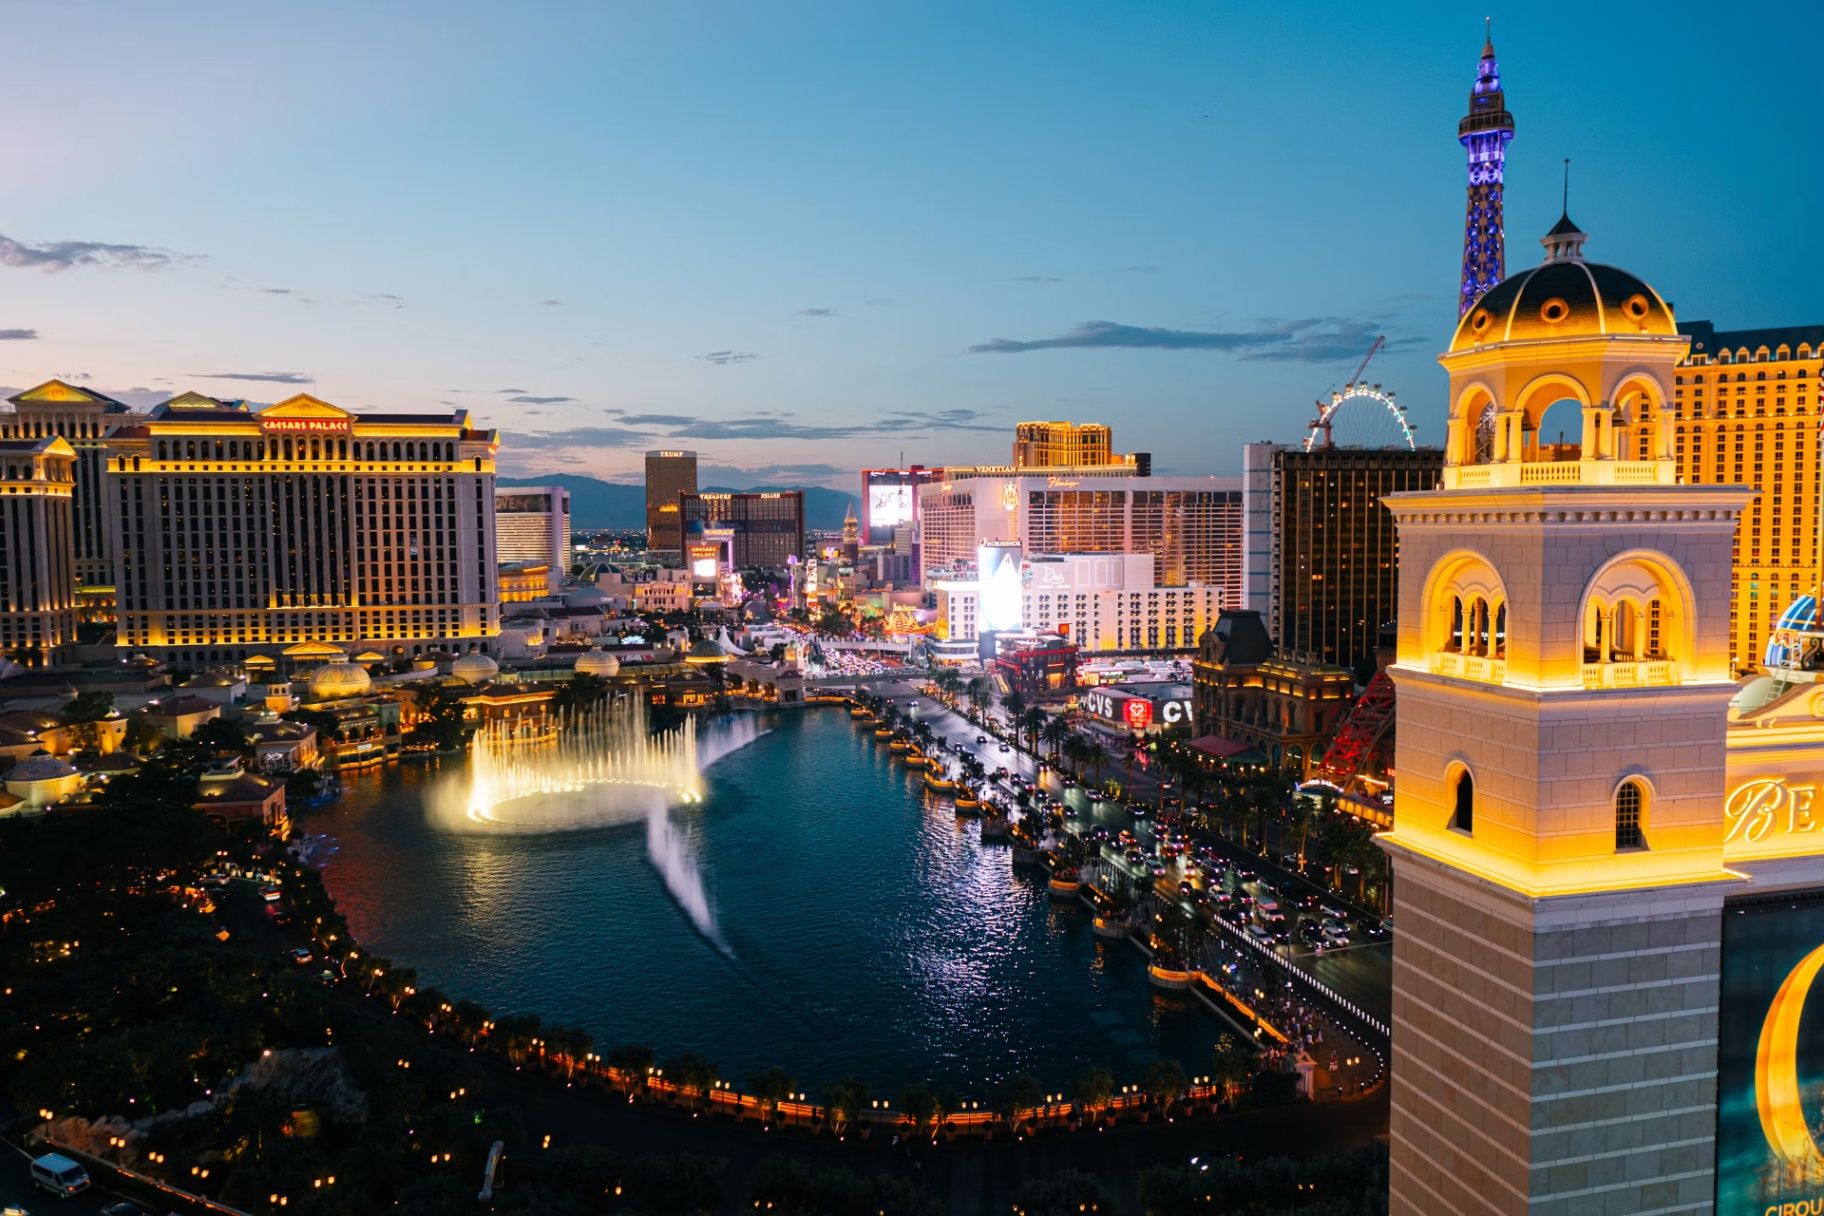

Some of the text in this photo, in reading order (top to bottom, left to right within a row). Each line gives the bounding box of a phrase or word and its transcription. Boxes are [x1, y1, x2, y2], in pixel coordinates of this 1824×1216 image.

[262, 421, 348, 430] CAESARS PALACE
[1088, 692, 1113, 718] CVS
[1723, 778, 1824, 844] BE
